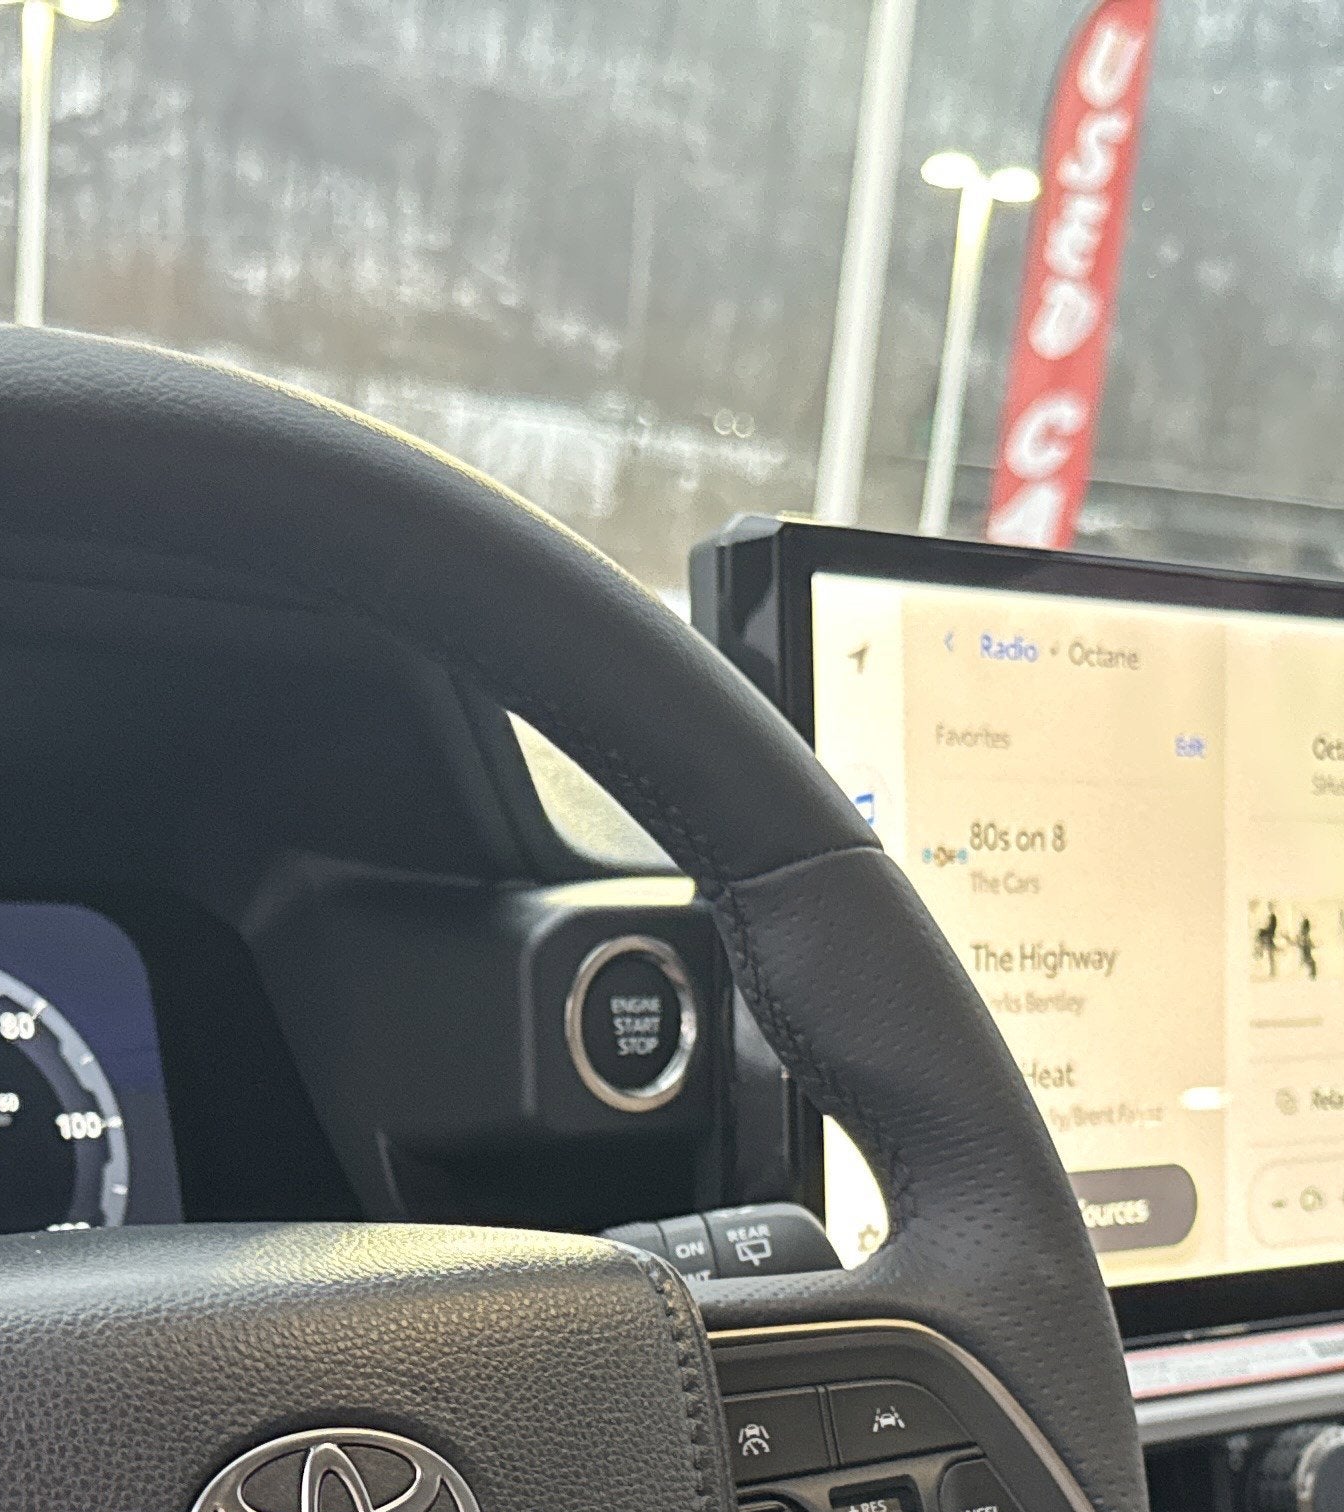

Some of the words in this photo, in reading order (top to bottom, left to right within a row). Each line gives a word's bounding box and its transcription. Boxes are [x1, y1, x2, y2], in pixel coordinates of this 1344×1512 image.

[1027, 20, 1145, 362] USED
[979, 632, 1040, 664] Radio
[1068, 640, 1141, 672] Octane
[935, 721, 1012, 750] Favorites
[968, 820, 1010, 852] 80s
[1014, 827, 1047, 852] on
[1050, 819, 1069, 853] 8
[969, 869, 1000, 896] The
[1002, 869, 1042, 896] Cars
[969, 942, 1015, 973] The
[1018, 942, 1120, 980] Highway
[609, 997, 661, 1015] ENGINE
[613, 1016, 661, 1036] START
[616, 1036, 660, 1057] STOP
[56, 1111, 104, 1140] 100
[725, 1222, 772, 1244] REAR
[675, 1240, 705, 1259] ON
